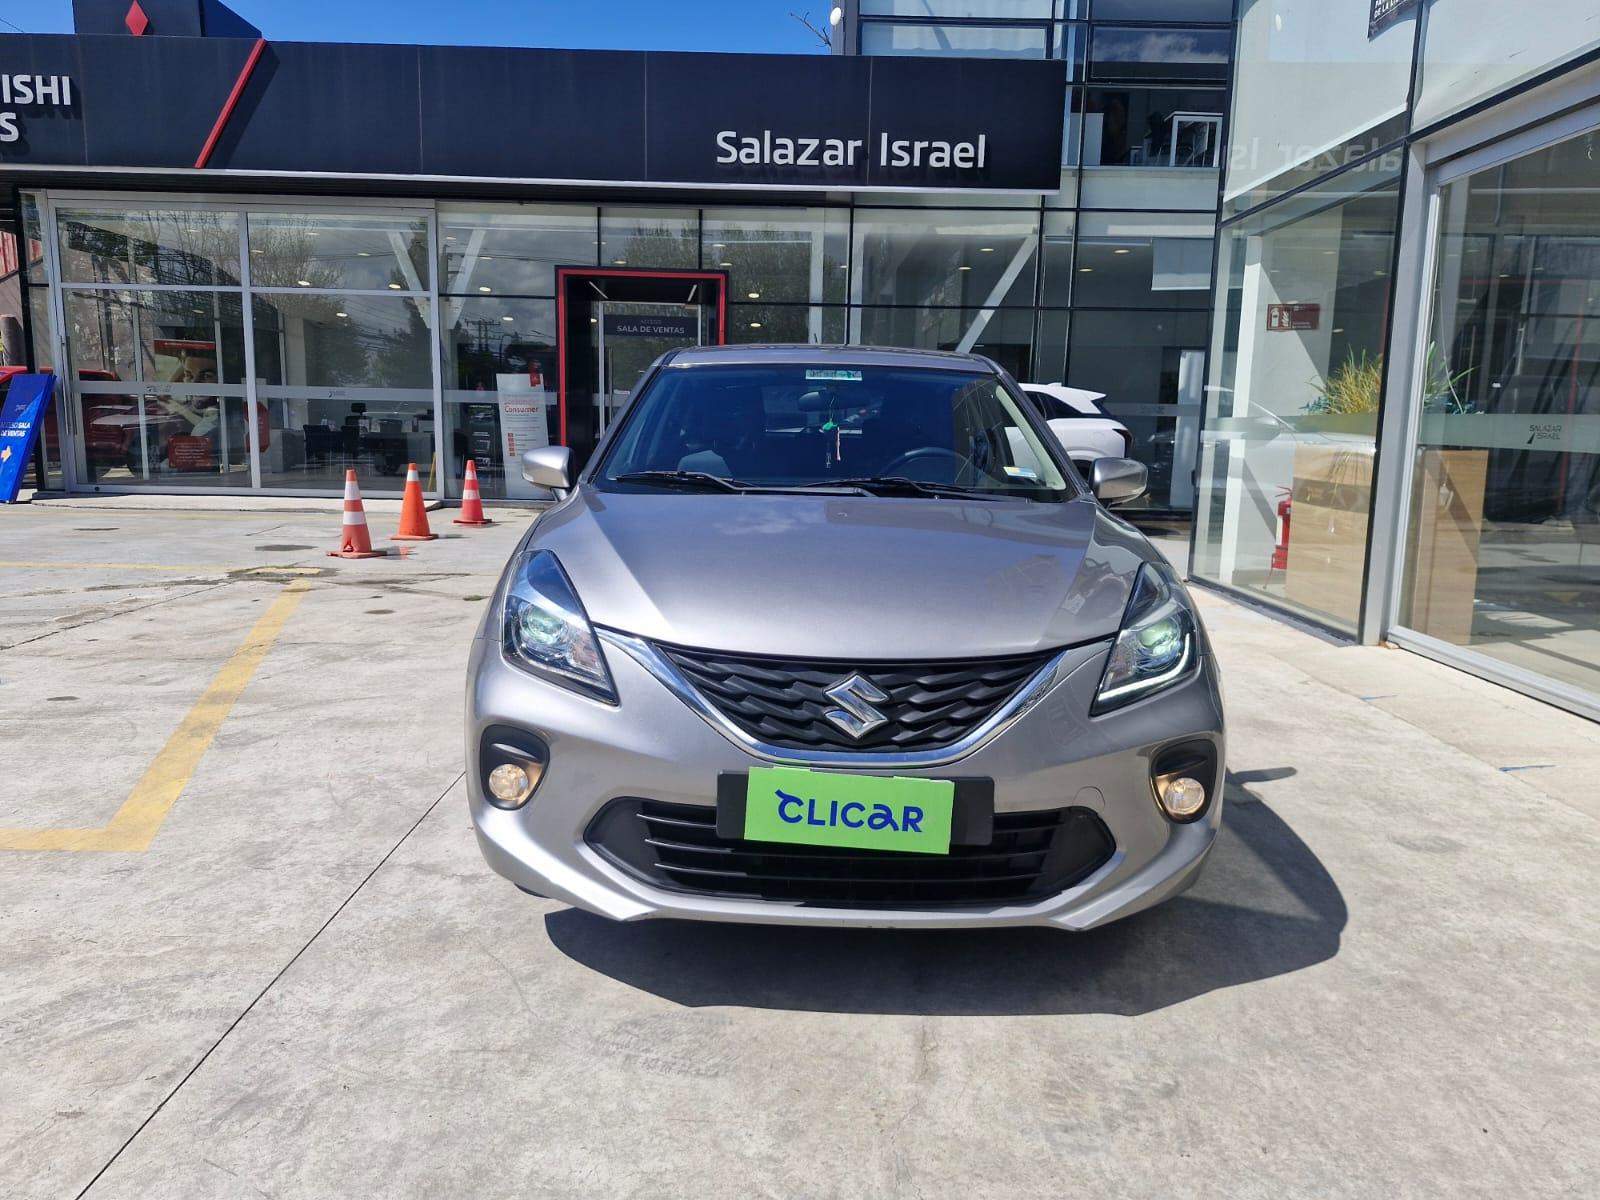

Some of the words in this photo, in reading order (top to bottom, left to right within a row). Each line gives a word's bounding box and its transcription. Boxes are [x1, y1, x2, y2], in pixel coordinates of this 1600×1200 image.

[1, 74, 71, 106] ISHI
[0, 112, 20, 142] S
[716, 130, 862, 166] Salazar
[880, 132, 986, 168] Israel
[617, 325, 638, 333] SALA
[652, 326, 685, 334] VENTAS
[504, 405, 539, 413] Consumer
